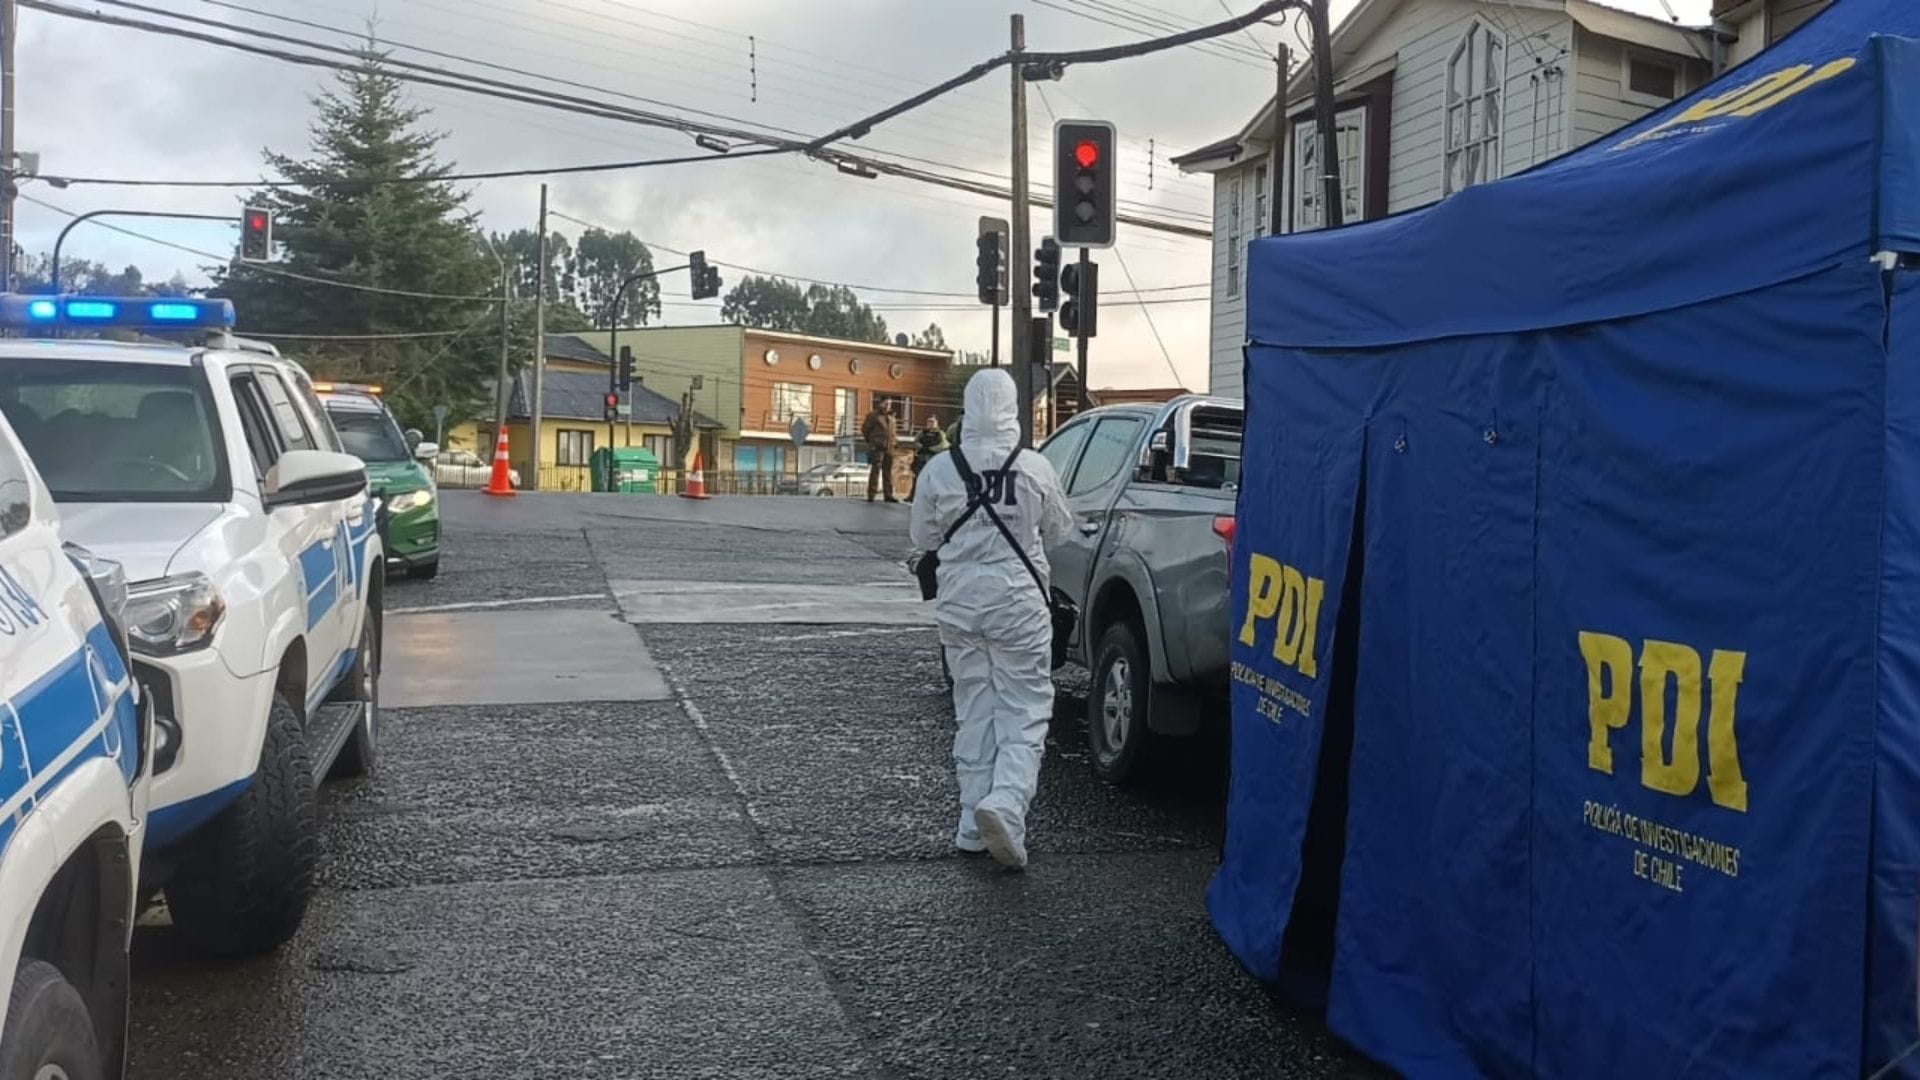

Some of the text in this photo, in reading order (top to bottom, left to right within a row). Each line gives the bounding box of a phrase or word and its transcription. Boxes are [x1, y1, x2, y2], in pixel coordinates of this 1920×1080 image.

[1238, 552, 1325, 679] PDI
[1578, 630, 1748, 814] PDI
[1584, 800, 1741, 877] POLICÍA DE INVESTIGACIONES
[1633, 850, 1684, 892] DE CHILE
